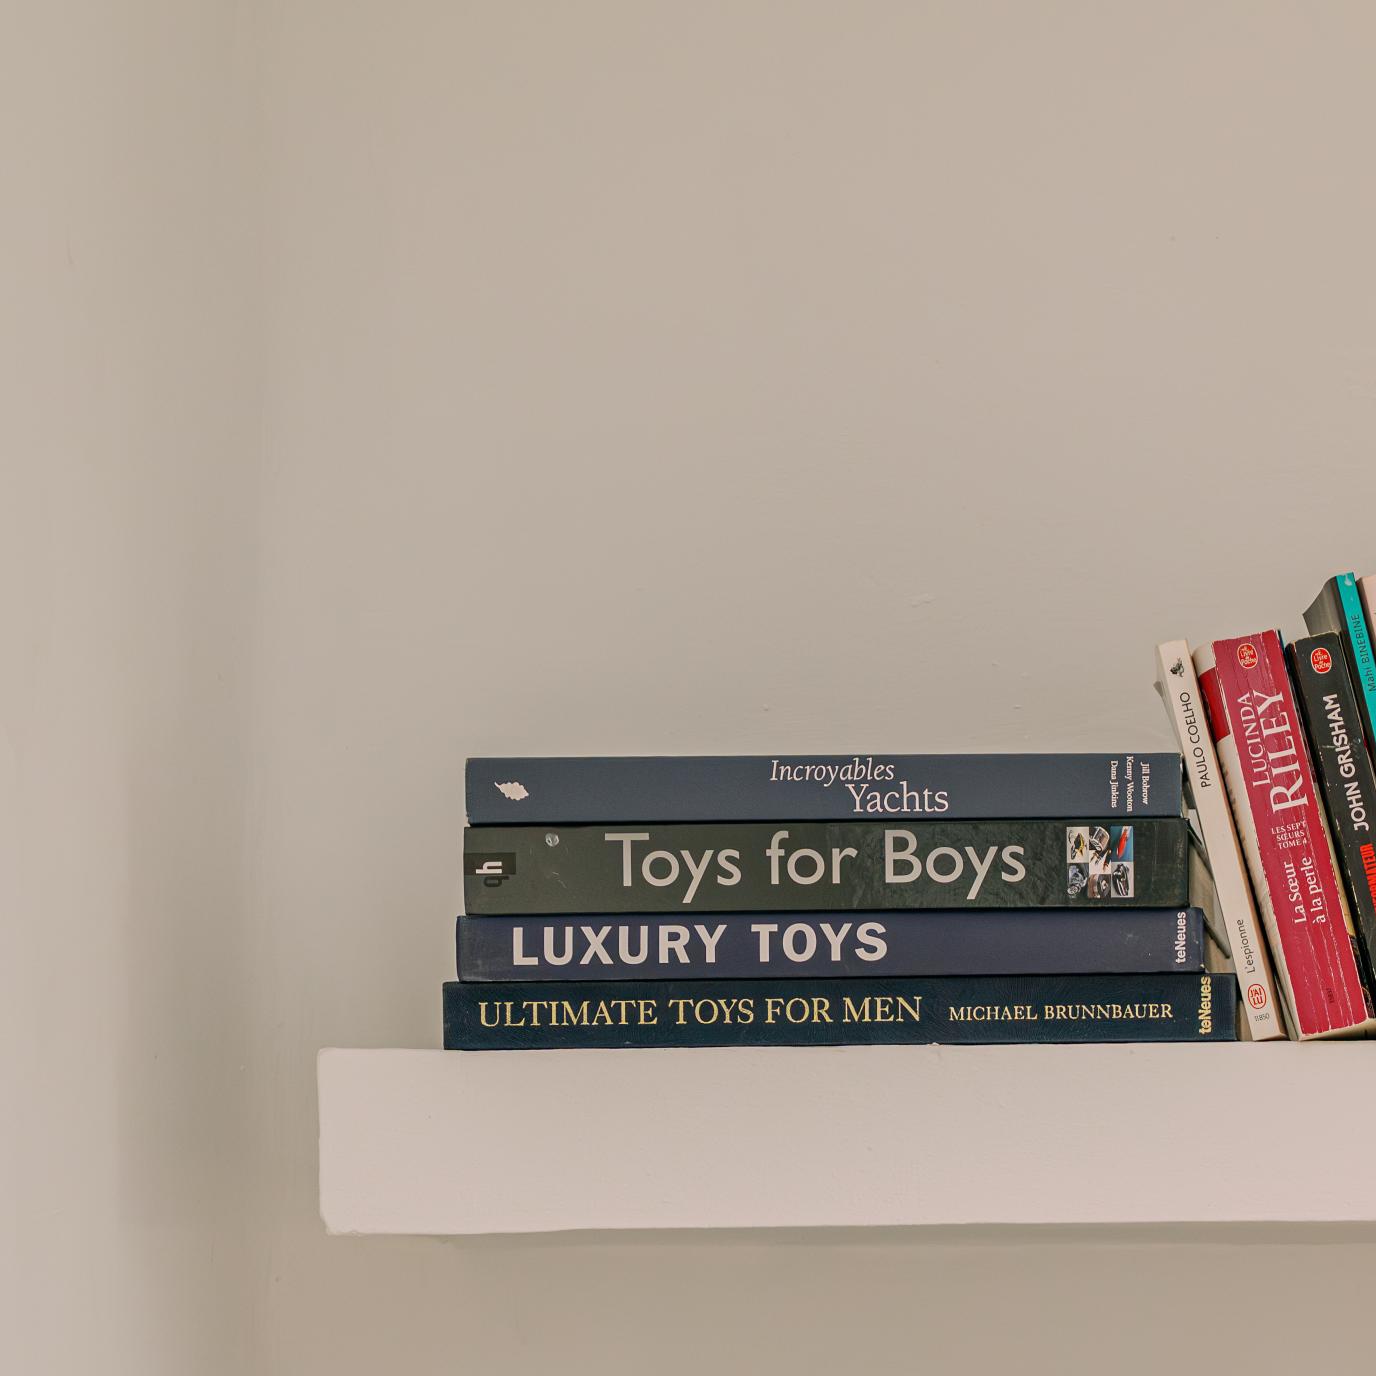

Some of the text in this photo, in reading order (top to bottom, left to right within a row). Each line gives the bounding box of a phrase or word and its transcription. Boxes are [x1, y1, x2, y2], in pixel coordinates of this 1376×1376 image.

[1362, 667, 1376, 693] Mahi
[1179, 691, 1212, 788] PAULO COELHO
[1237, 691, 1271, 788] LUCINDA
[1253, 689, 1310, 813] RILEY
[1322, 693, 1370, 832] JOHN GRISHAM
[769, 754, 895, 787] Incroyables
[845, 780, 949, 813] Yachts
[1271, 825, 1286, 835] LES
[1276, 830, 1305, 842] SŒURS
[1278, 838, 1302, 850] TOME
[604, 829, 1026, 904] Toys for Boys
[1283, 861, 1307, 924] La Sœur
[1300, 856, 1326, 924] à la perle
[512, 920, 888, 966] LUXURY TOYS
[1174, 910, 1187, 964] teNeues
[1236, 918, 1256, 975] L'espionne
[478, 996, 923, 1027] ULTIMATE TOYS FOR MEN
[949, 1002, 1174, 1022] MICHAEL BRUNNBAUER
[1199, 975, 1212, 1035] teNeues
